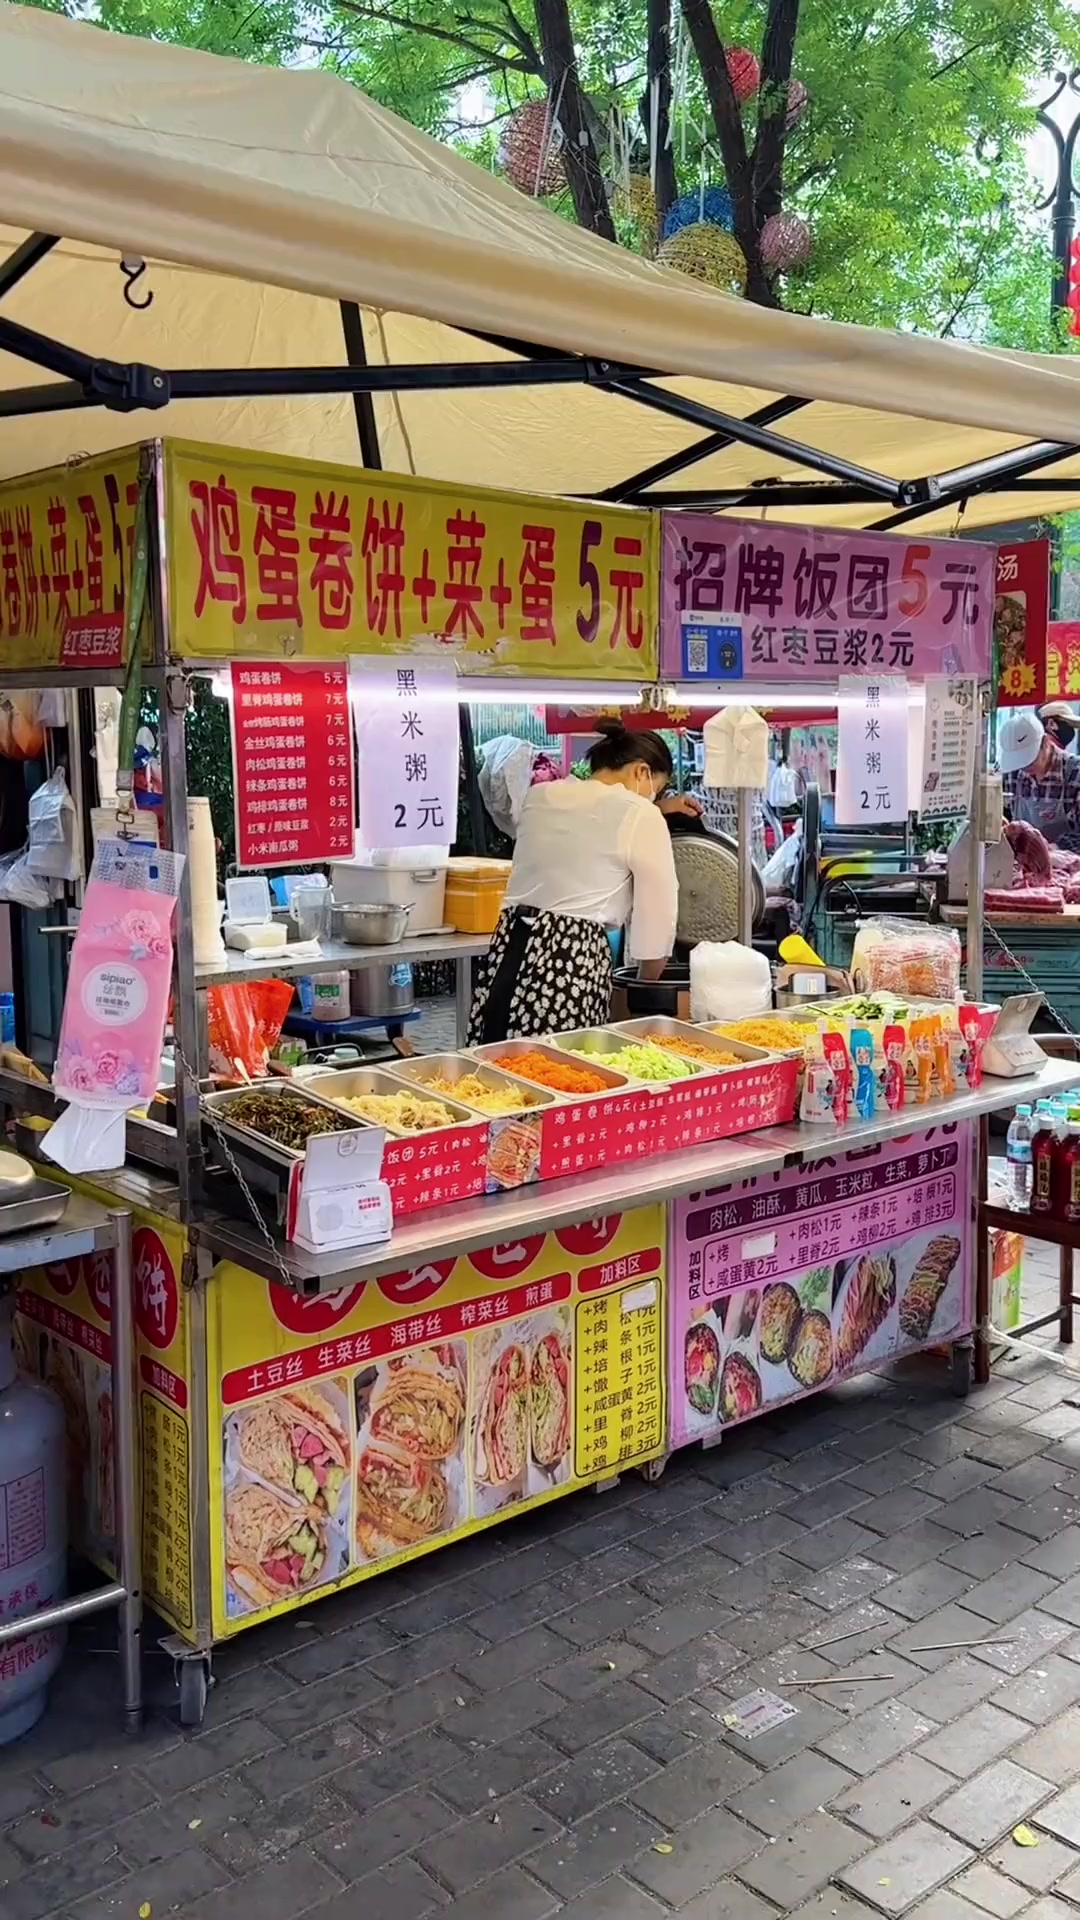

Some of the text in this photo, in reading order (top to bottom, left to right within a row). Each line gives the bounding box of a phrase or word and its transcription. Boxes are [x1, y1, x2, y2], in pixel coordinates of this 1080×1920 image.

[63, 626, 121, 656] 红枣豆浆
[750, 624, 915, 668] 红枣豆浆2元
[240, 671, 343, 685] 鸡蛋卷饼 5元
[325, 692, 344, 705] 7元
[326, 714, 344, 725] 7元
[396, 668, 428, 782] 黑米粥
[327, 734, 346, 746] 6元
[328, 754, 347, 767] 6元
[329, 774, 347, 787] 6元
[329, 794, 348, 807] 8元
[860, 786, 891, 811] 2元
[329, 815, 348, 827] 2元
[394, 797, 445, 831] 2元
[330, 835, 349, 848] 2元
[600, 1255, 641, 1285] 加料区
[689, 1252, 702, 1300] 加料区
[247, 1283, 553, 1392] 土豆丝 生菜丝 海带丝 榨菜丝 煎蛋
[152, 1365, 177, 1399] 加料区
